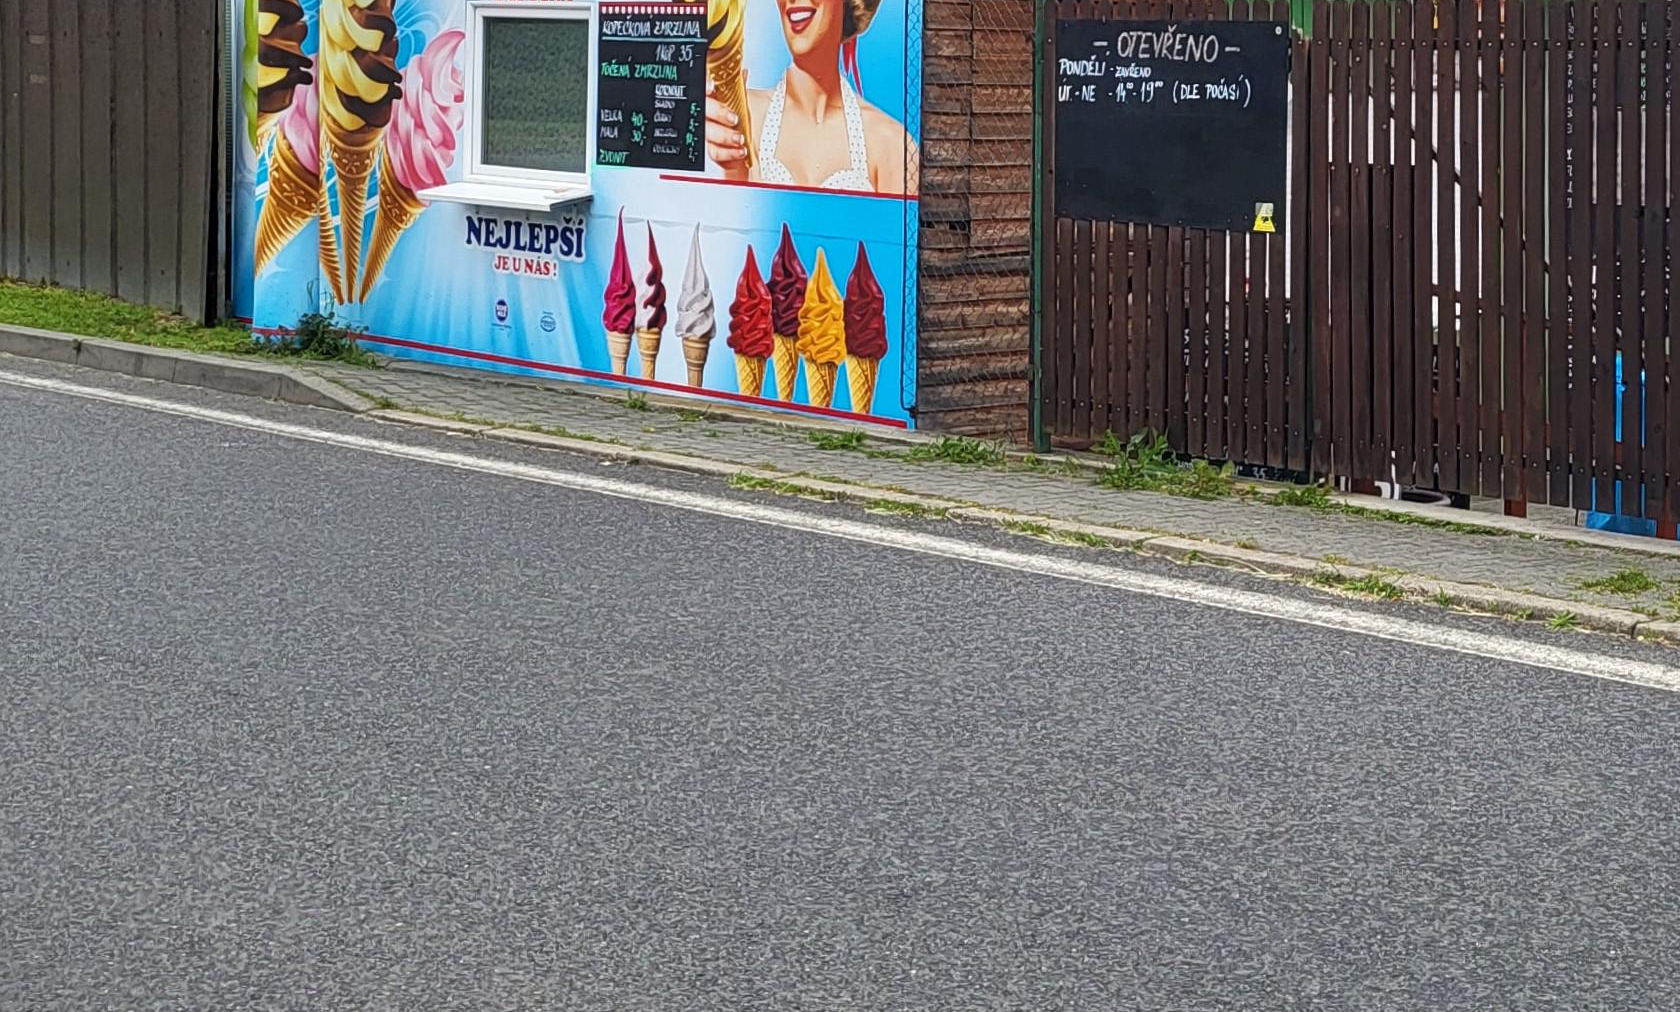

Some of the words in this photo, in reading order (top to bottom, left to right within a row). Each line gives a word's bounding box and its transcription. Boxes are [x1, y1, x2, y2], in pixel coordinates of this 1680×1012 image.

[602, 15, 651, 37] KOPEČKOVÁ
[653, 20, 702, 38] ZMRZLINA
[1117, 24, 1219, 63] OTEVŘENO
[601, 56, 631, 78] TOČENÁ
[634, 63, 678, 81] ZMRZLINA
[1058, 51, 1110, 76] PONDĚLÍ
[1115, 62, 1151, 78] ZAVŘENO
[465, 216, 584, 258] NEJLEPŠÍ
[495, 256, 509, 270] JE
[512, 257, 521, 272] U
